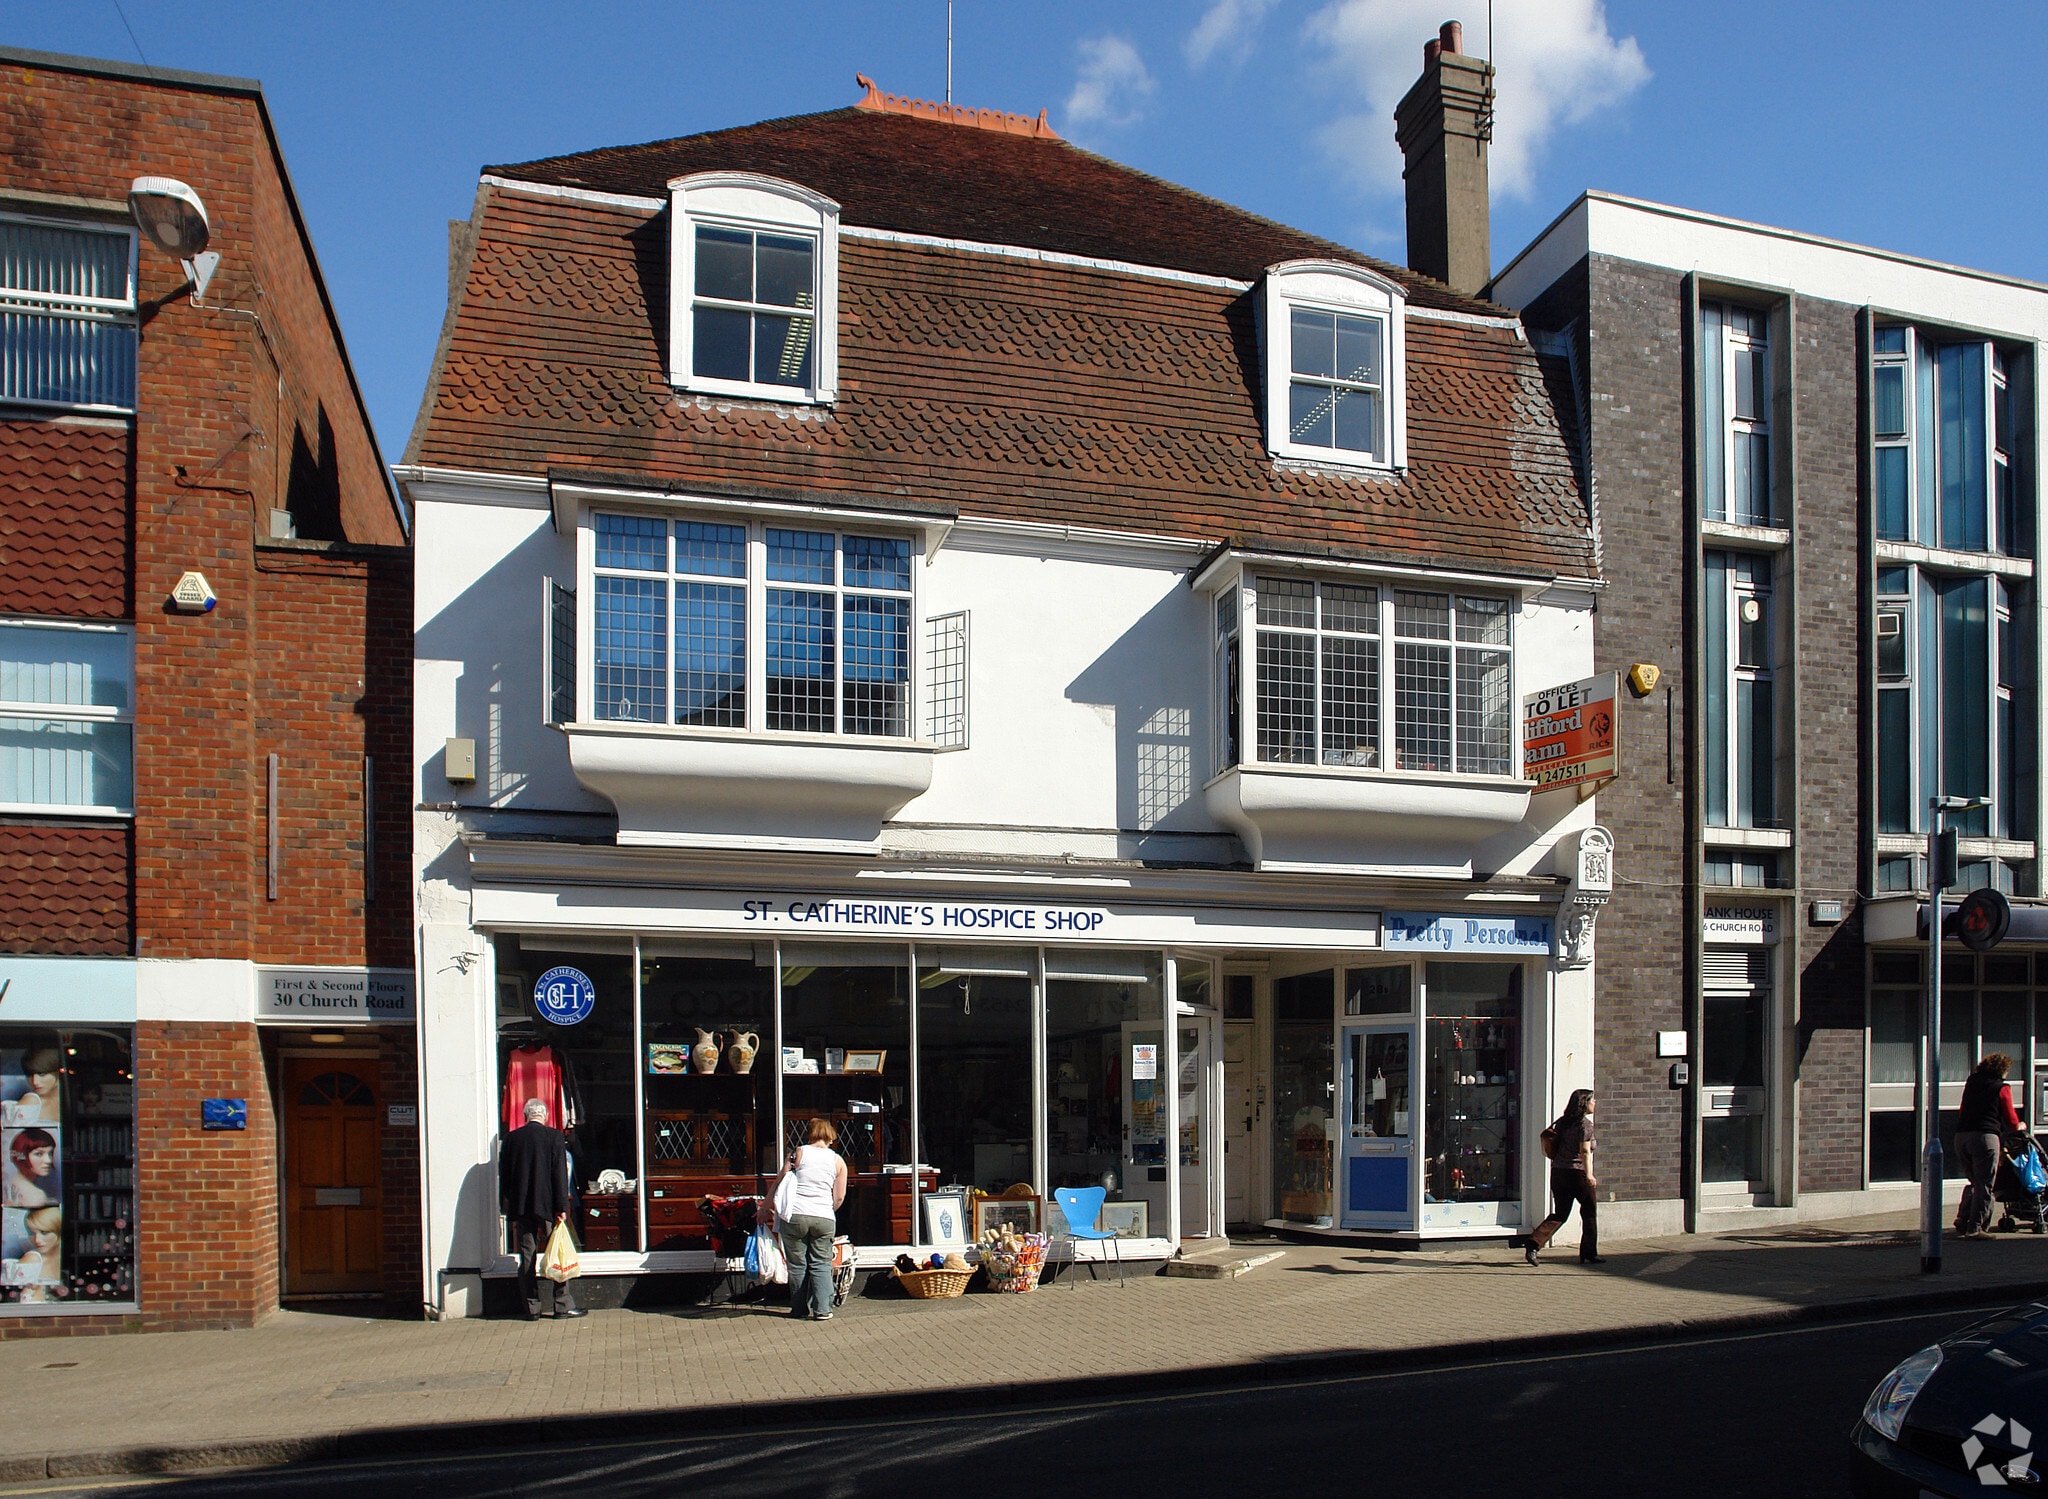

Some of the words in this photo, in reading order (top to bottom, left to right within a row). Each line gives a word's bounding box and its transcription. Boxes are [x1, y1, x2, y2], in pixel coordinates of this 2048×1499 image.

[1538, 682, 1578, 700] OFFICES
[1524, 700, 1550, 718] TO
[1558, 688, 1592, 710] LET
[1524, 741, 1566, 764] ann
[1590, 740, 1610, 750] RICS
[1544, 762, 1586, 783] 247511
[742, 900, 779, 922] ST.
[788, 901, 934, 926] CATHERINE'S
[943, 906, 1036, 930] HOSPICE
[1044, 910, 1104, 932] SHOP
[1704, 906, 1731, 918] ANK
[1734, 908, 1774, 919] HOUSE
[1390, 916, 1454, 951] Pretty
[1464, 920, 1549, 947] Personal
[1710, 922, 1746, 932] CHURCH
[1748, 924, 1774, 932] ROAD
[274, 979, 302, 990] First
[308, 980, 317, 990] &
[322, 980, 364, 991] Second
[368, 981, 406, 992] Floors
[273, 993, 292, 1006] 30
[298, 993, 358, 1008] Church
[365, 995, 405, 1008] Road
[548, 1012, 582, 1023] HOSPICE
